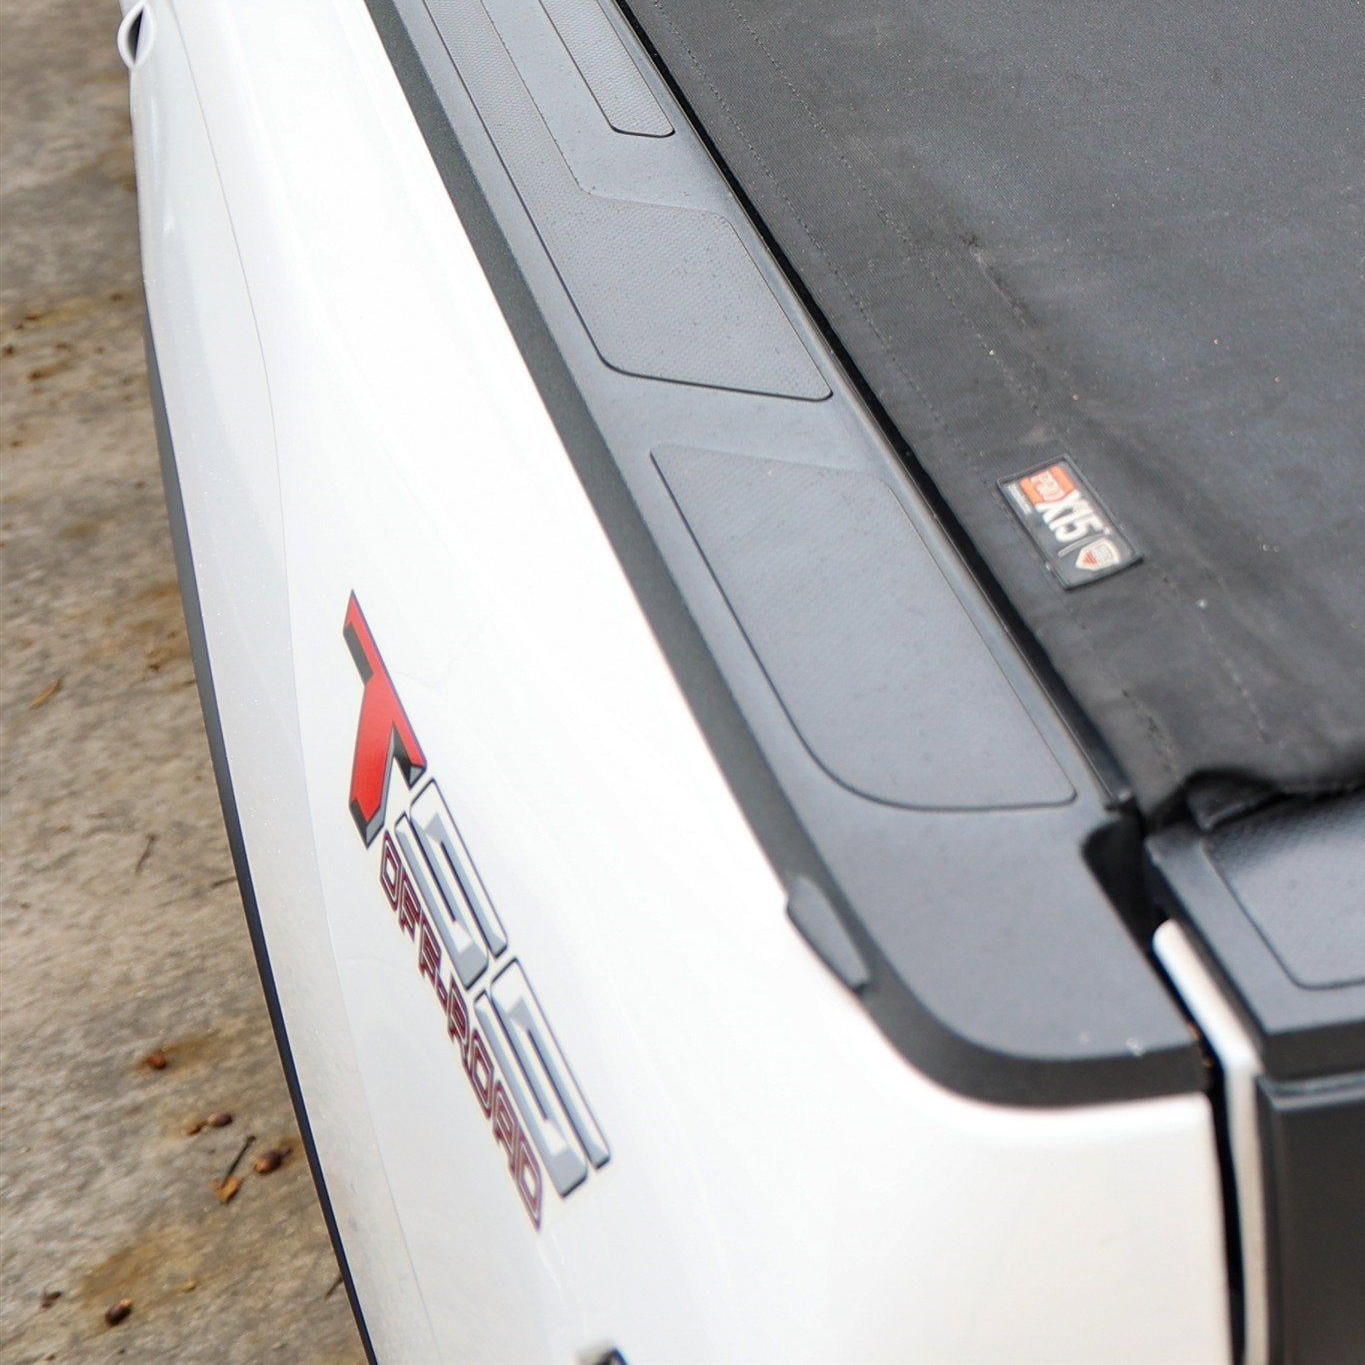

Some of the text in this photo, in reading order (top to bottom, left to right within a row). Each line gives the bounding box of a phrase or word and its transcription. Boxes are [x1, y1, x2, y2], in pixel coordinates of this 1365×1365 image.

[1034, 489, 1104, 542] X15
[342, 590, 612, 1199] TSS
[378, 830, 543, 1233] OFF-ROAD
